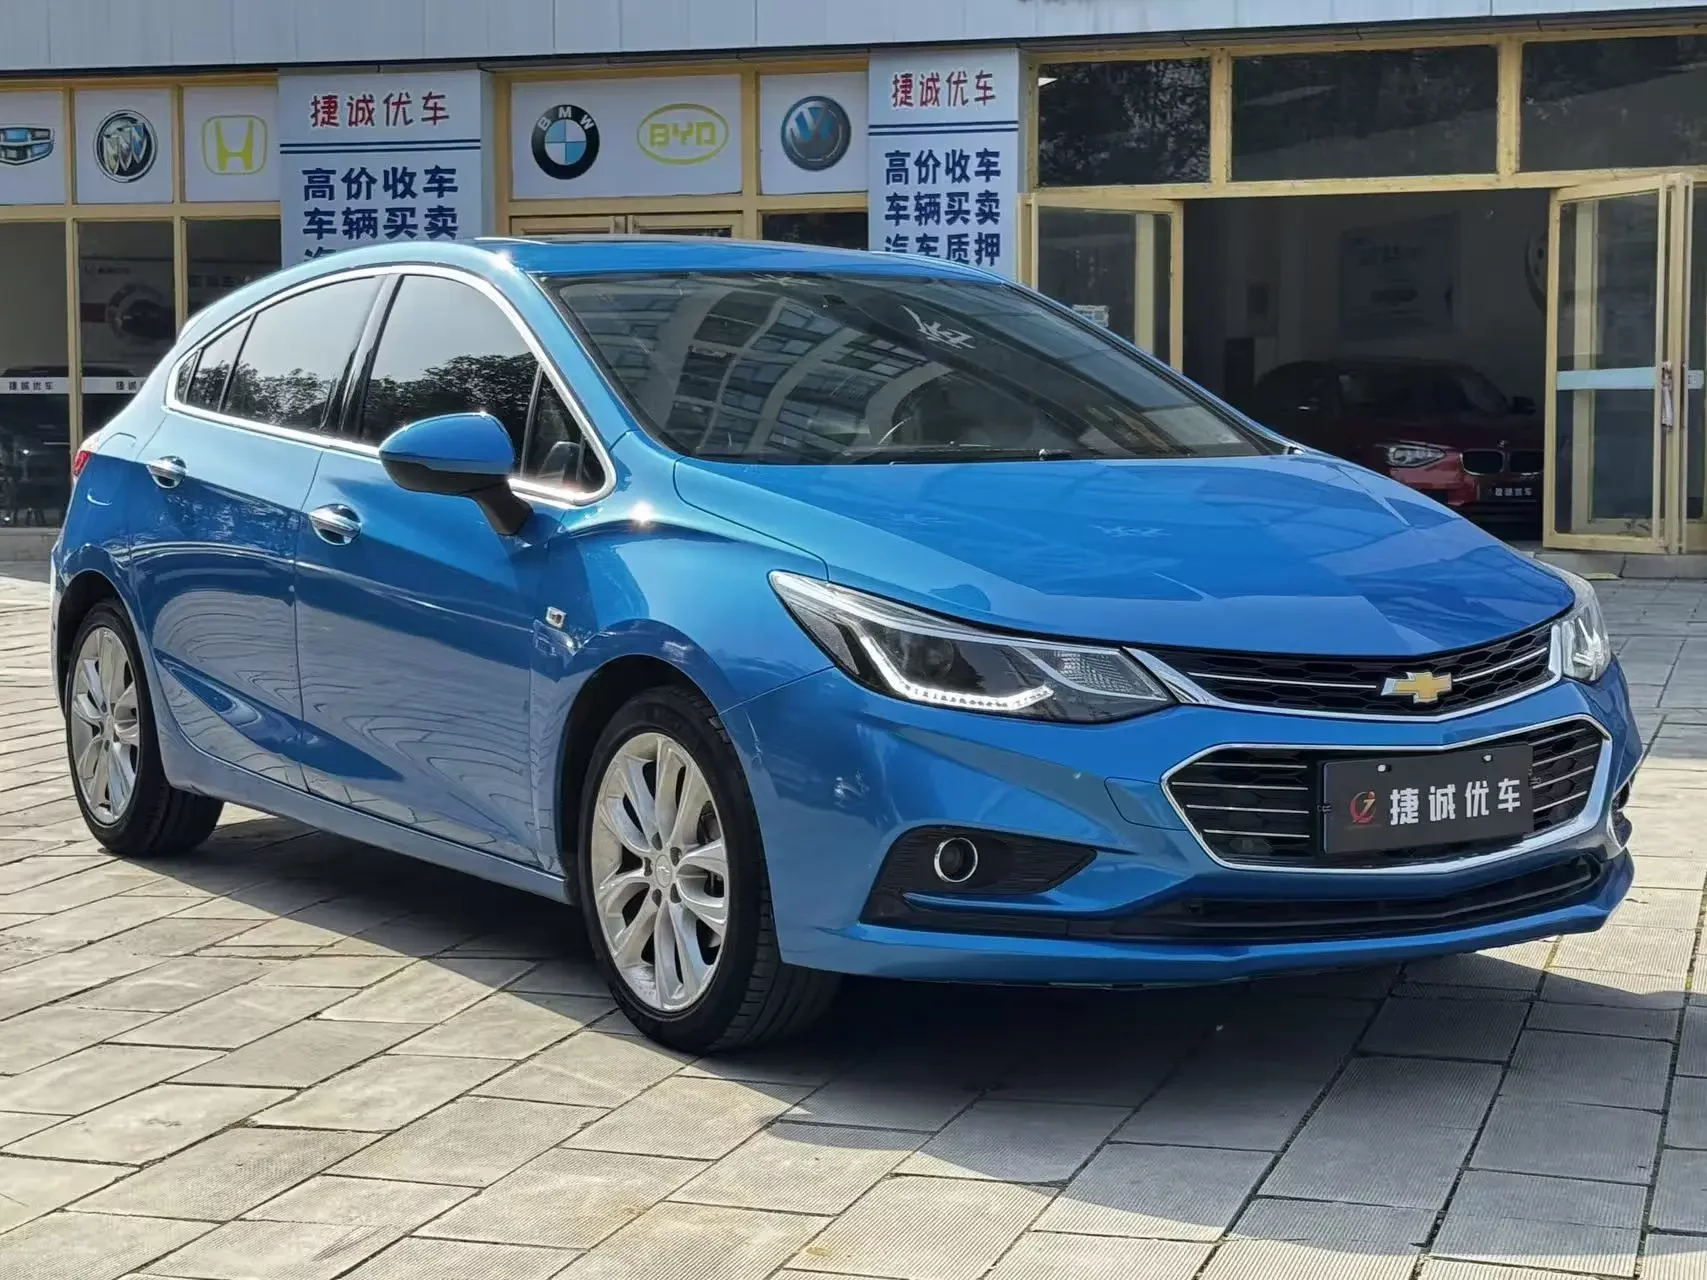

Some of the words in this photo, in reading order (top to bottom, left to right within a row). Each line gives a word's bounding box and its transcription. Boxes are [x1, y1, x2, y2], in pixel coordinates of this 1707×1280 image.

[891, 70, 996, 107] 捷诚优车
[311, 91, 450, 127] 捷诚优车
[538, 105, 595, 131] BMW
[649, 120, 716, 148] BYD
[302, 165, 459, 201] 高价收车
[885, 148, 1001, 185] 高价收车
[302, 205, 459, 240] 车辆买卖
[885, 190, 1001, 226] 车辆买卖
[1389, 778, 1520, 825] 捷诚优车
